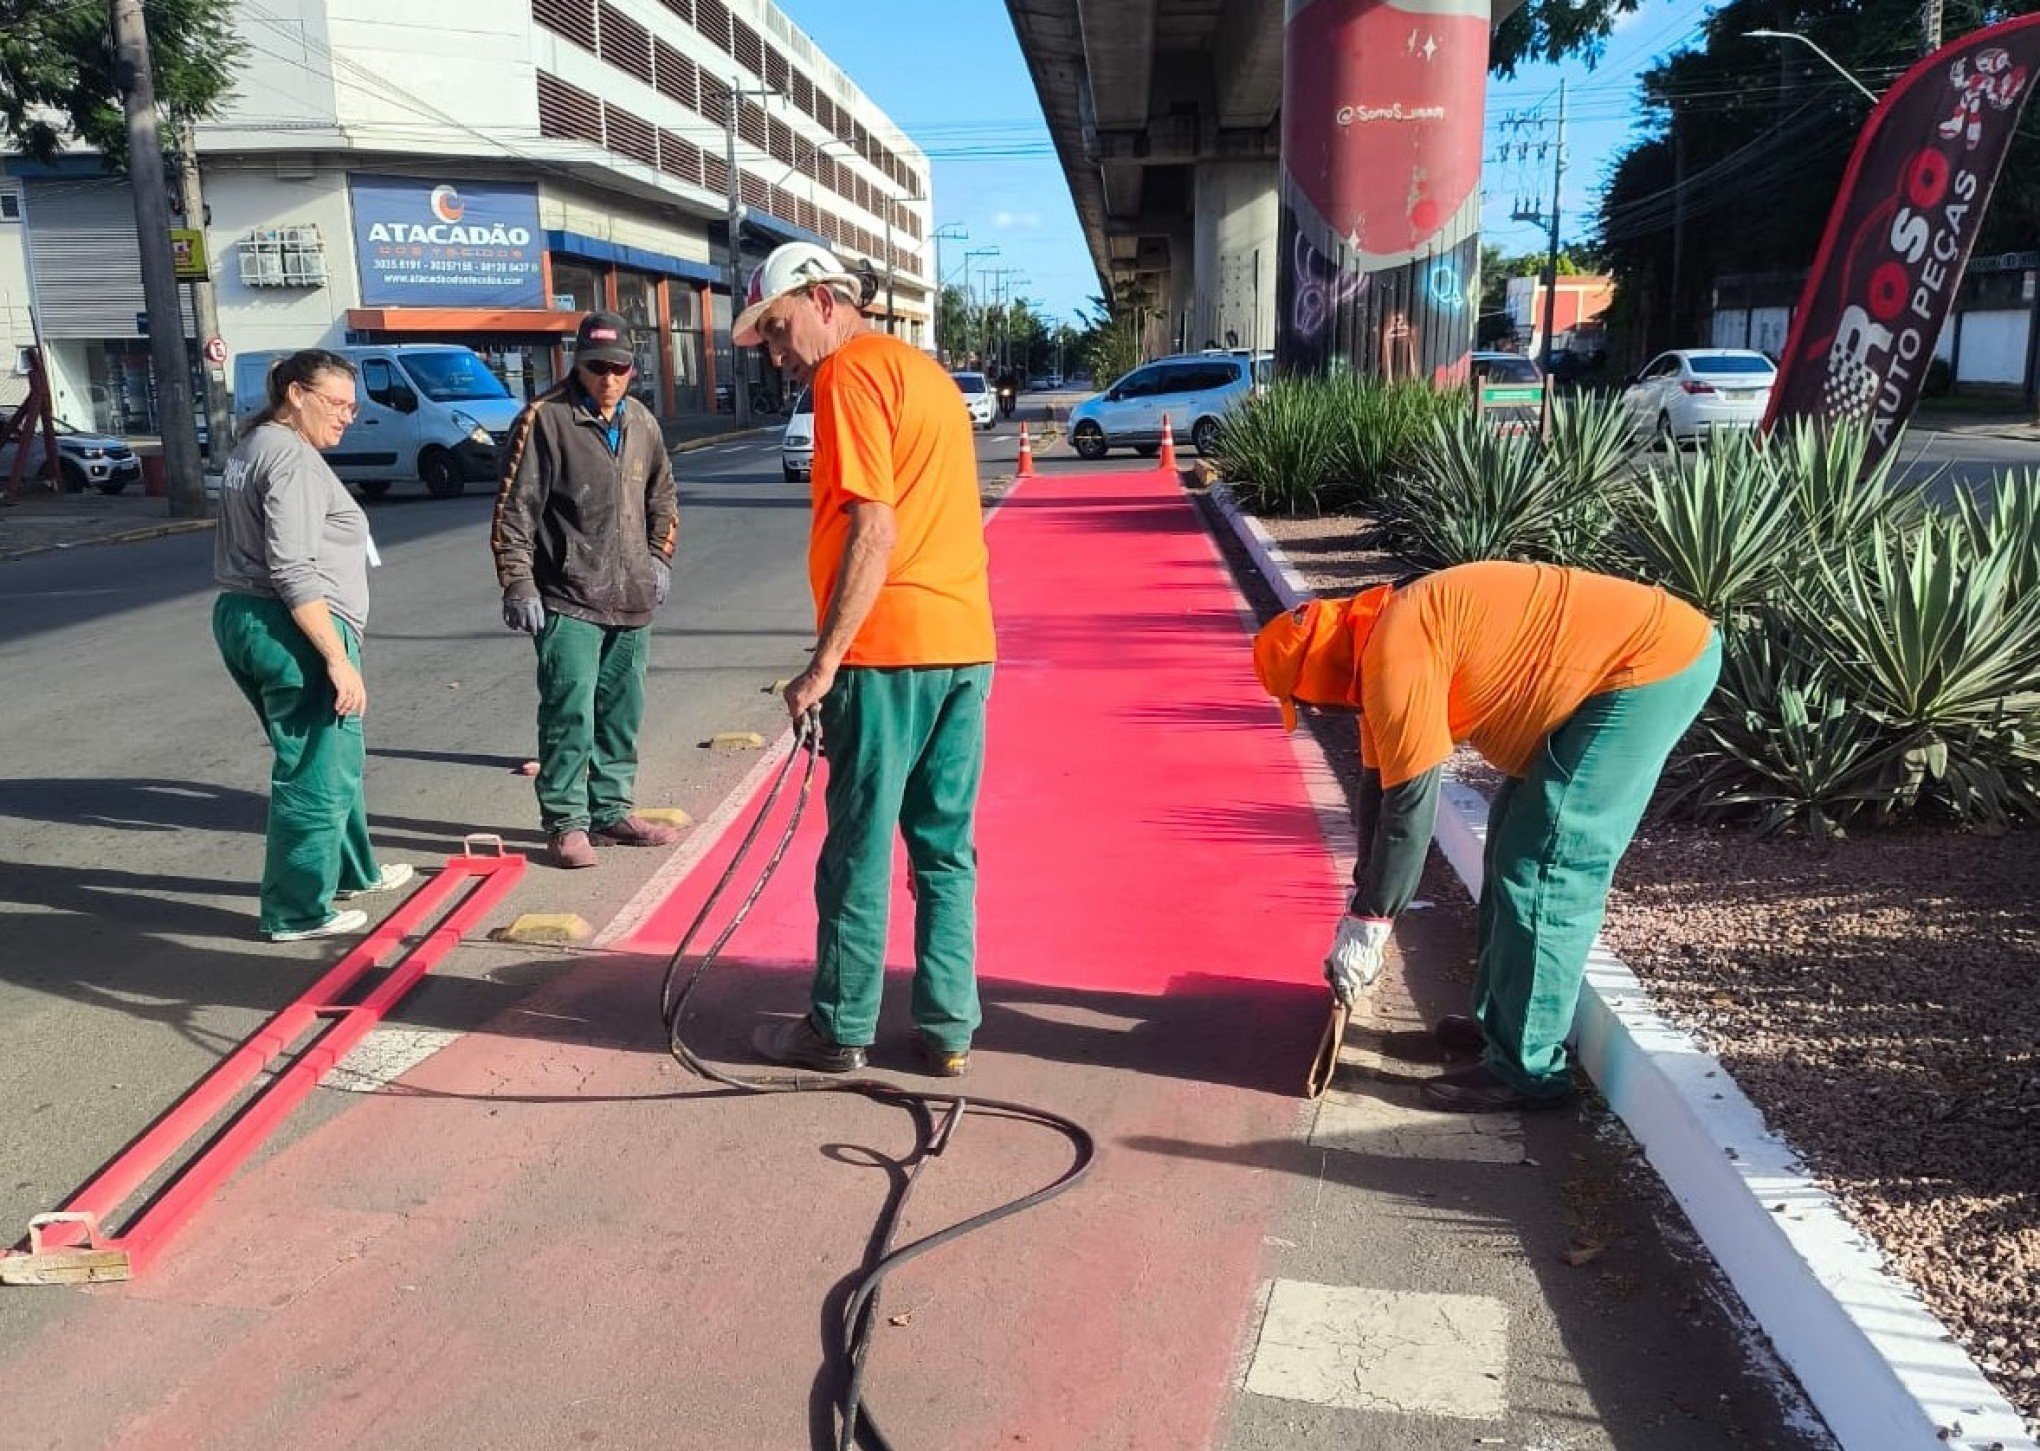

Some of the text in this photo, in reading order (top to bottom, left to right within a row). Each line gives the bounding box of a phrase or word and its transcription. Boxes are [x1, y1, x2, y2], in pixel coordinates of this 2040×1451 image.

[368, 222, 531, 246] ATACADÃO
[1824, 148, 1949, 416] ROSO
[1872, 169, 1977, 445] AUTO PEÇAS
